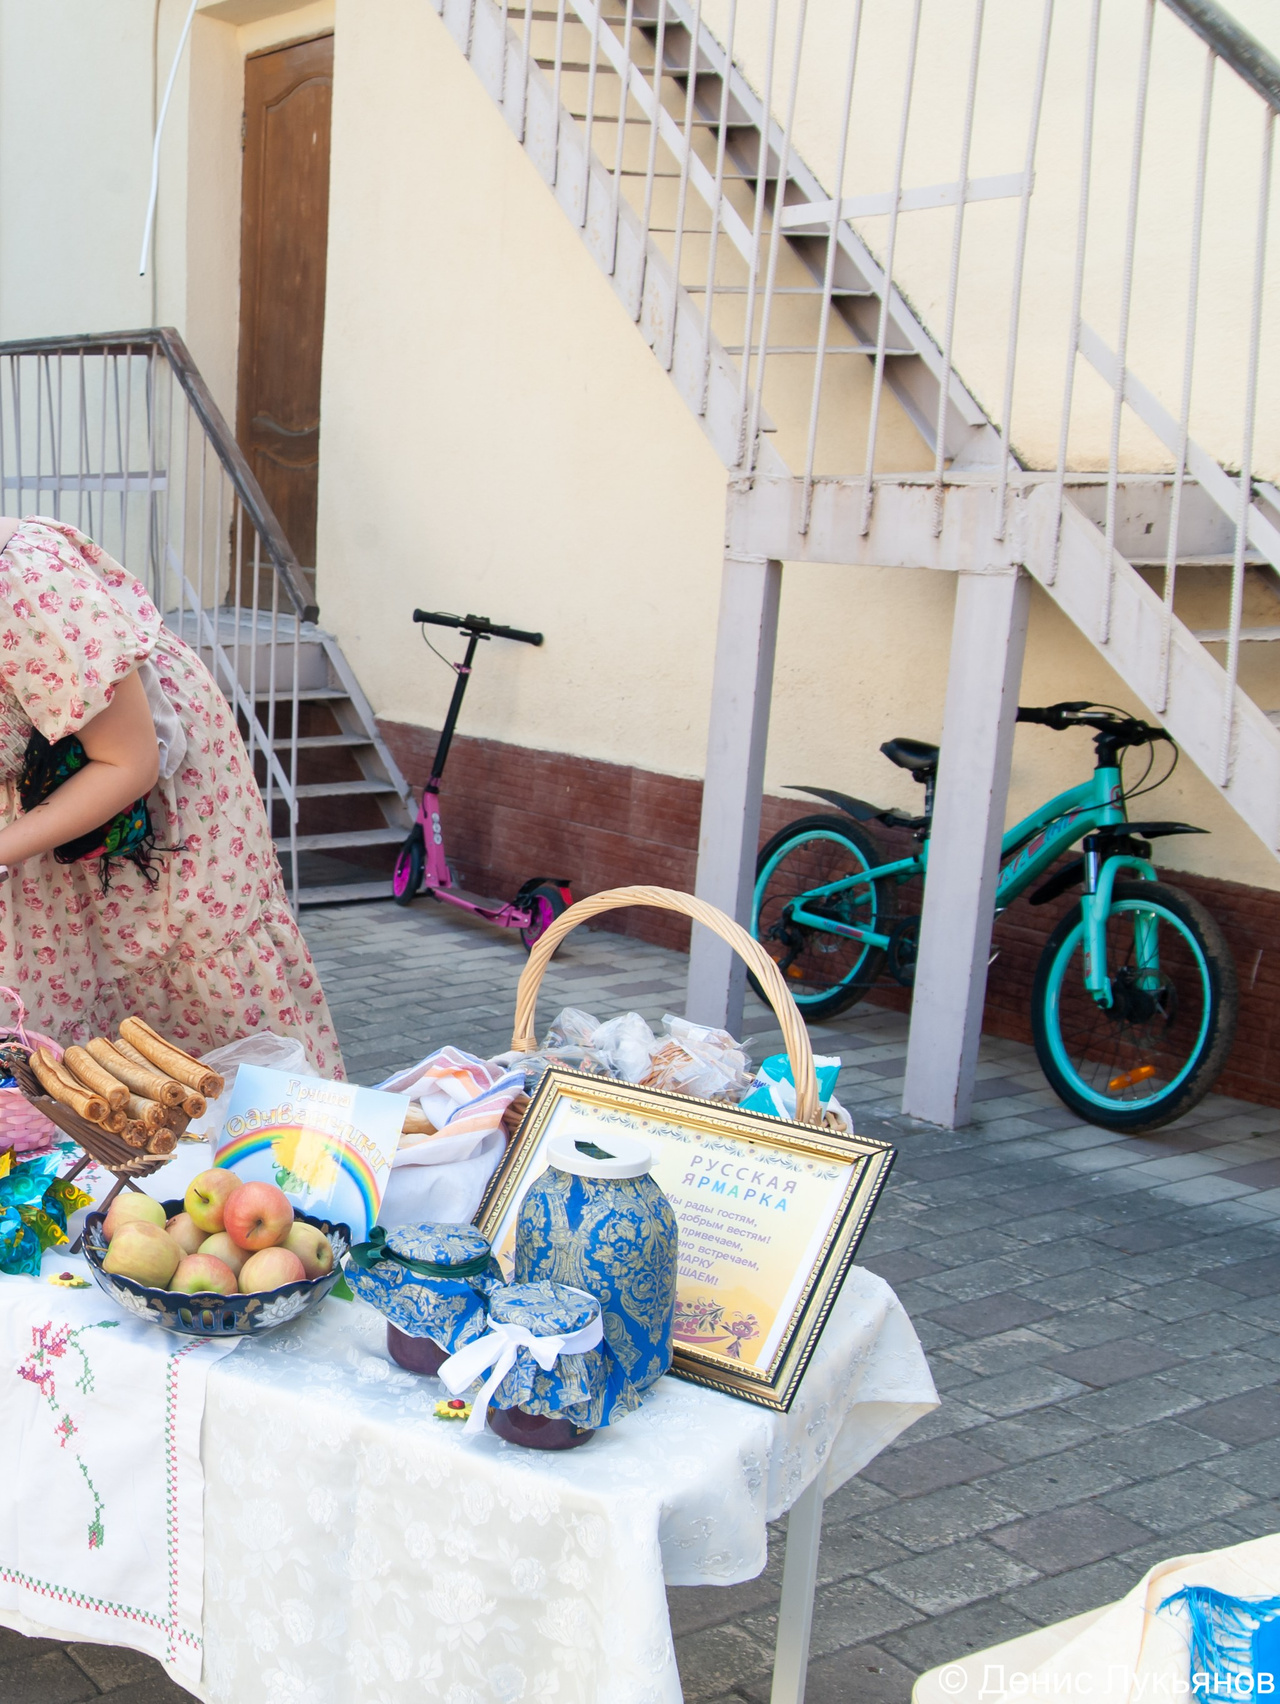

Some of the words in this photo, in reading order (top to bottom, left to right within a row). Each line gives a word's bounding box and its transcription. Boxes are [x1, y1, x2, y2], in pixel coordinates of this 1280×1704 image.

[286, 1079, 351, 1108] Группа
[690, 1155, 797, 1194] РУССКАЯ
[681, 1173, 787, 1212] ЯРМАРКА
[665, 1193, 683, 1205] Мы
[684, 1200, 714, 1214] рады
[717, 1209, 758, 1227] гостям,
[678, 1212, 724, 1230] добрым
[726, 1225, 772, 1244] вестям!
[681, 1226, 744, 1252] привечаем,
[677, 1251, 715, 1269] МАРКУ
[698, 1245, 760, 1271] встречаем,
[678, 1265, 719, 1286] ШАЕМ!
